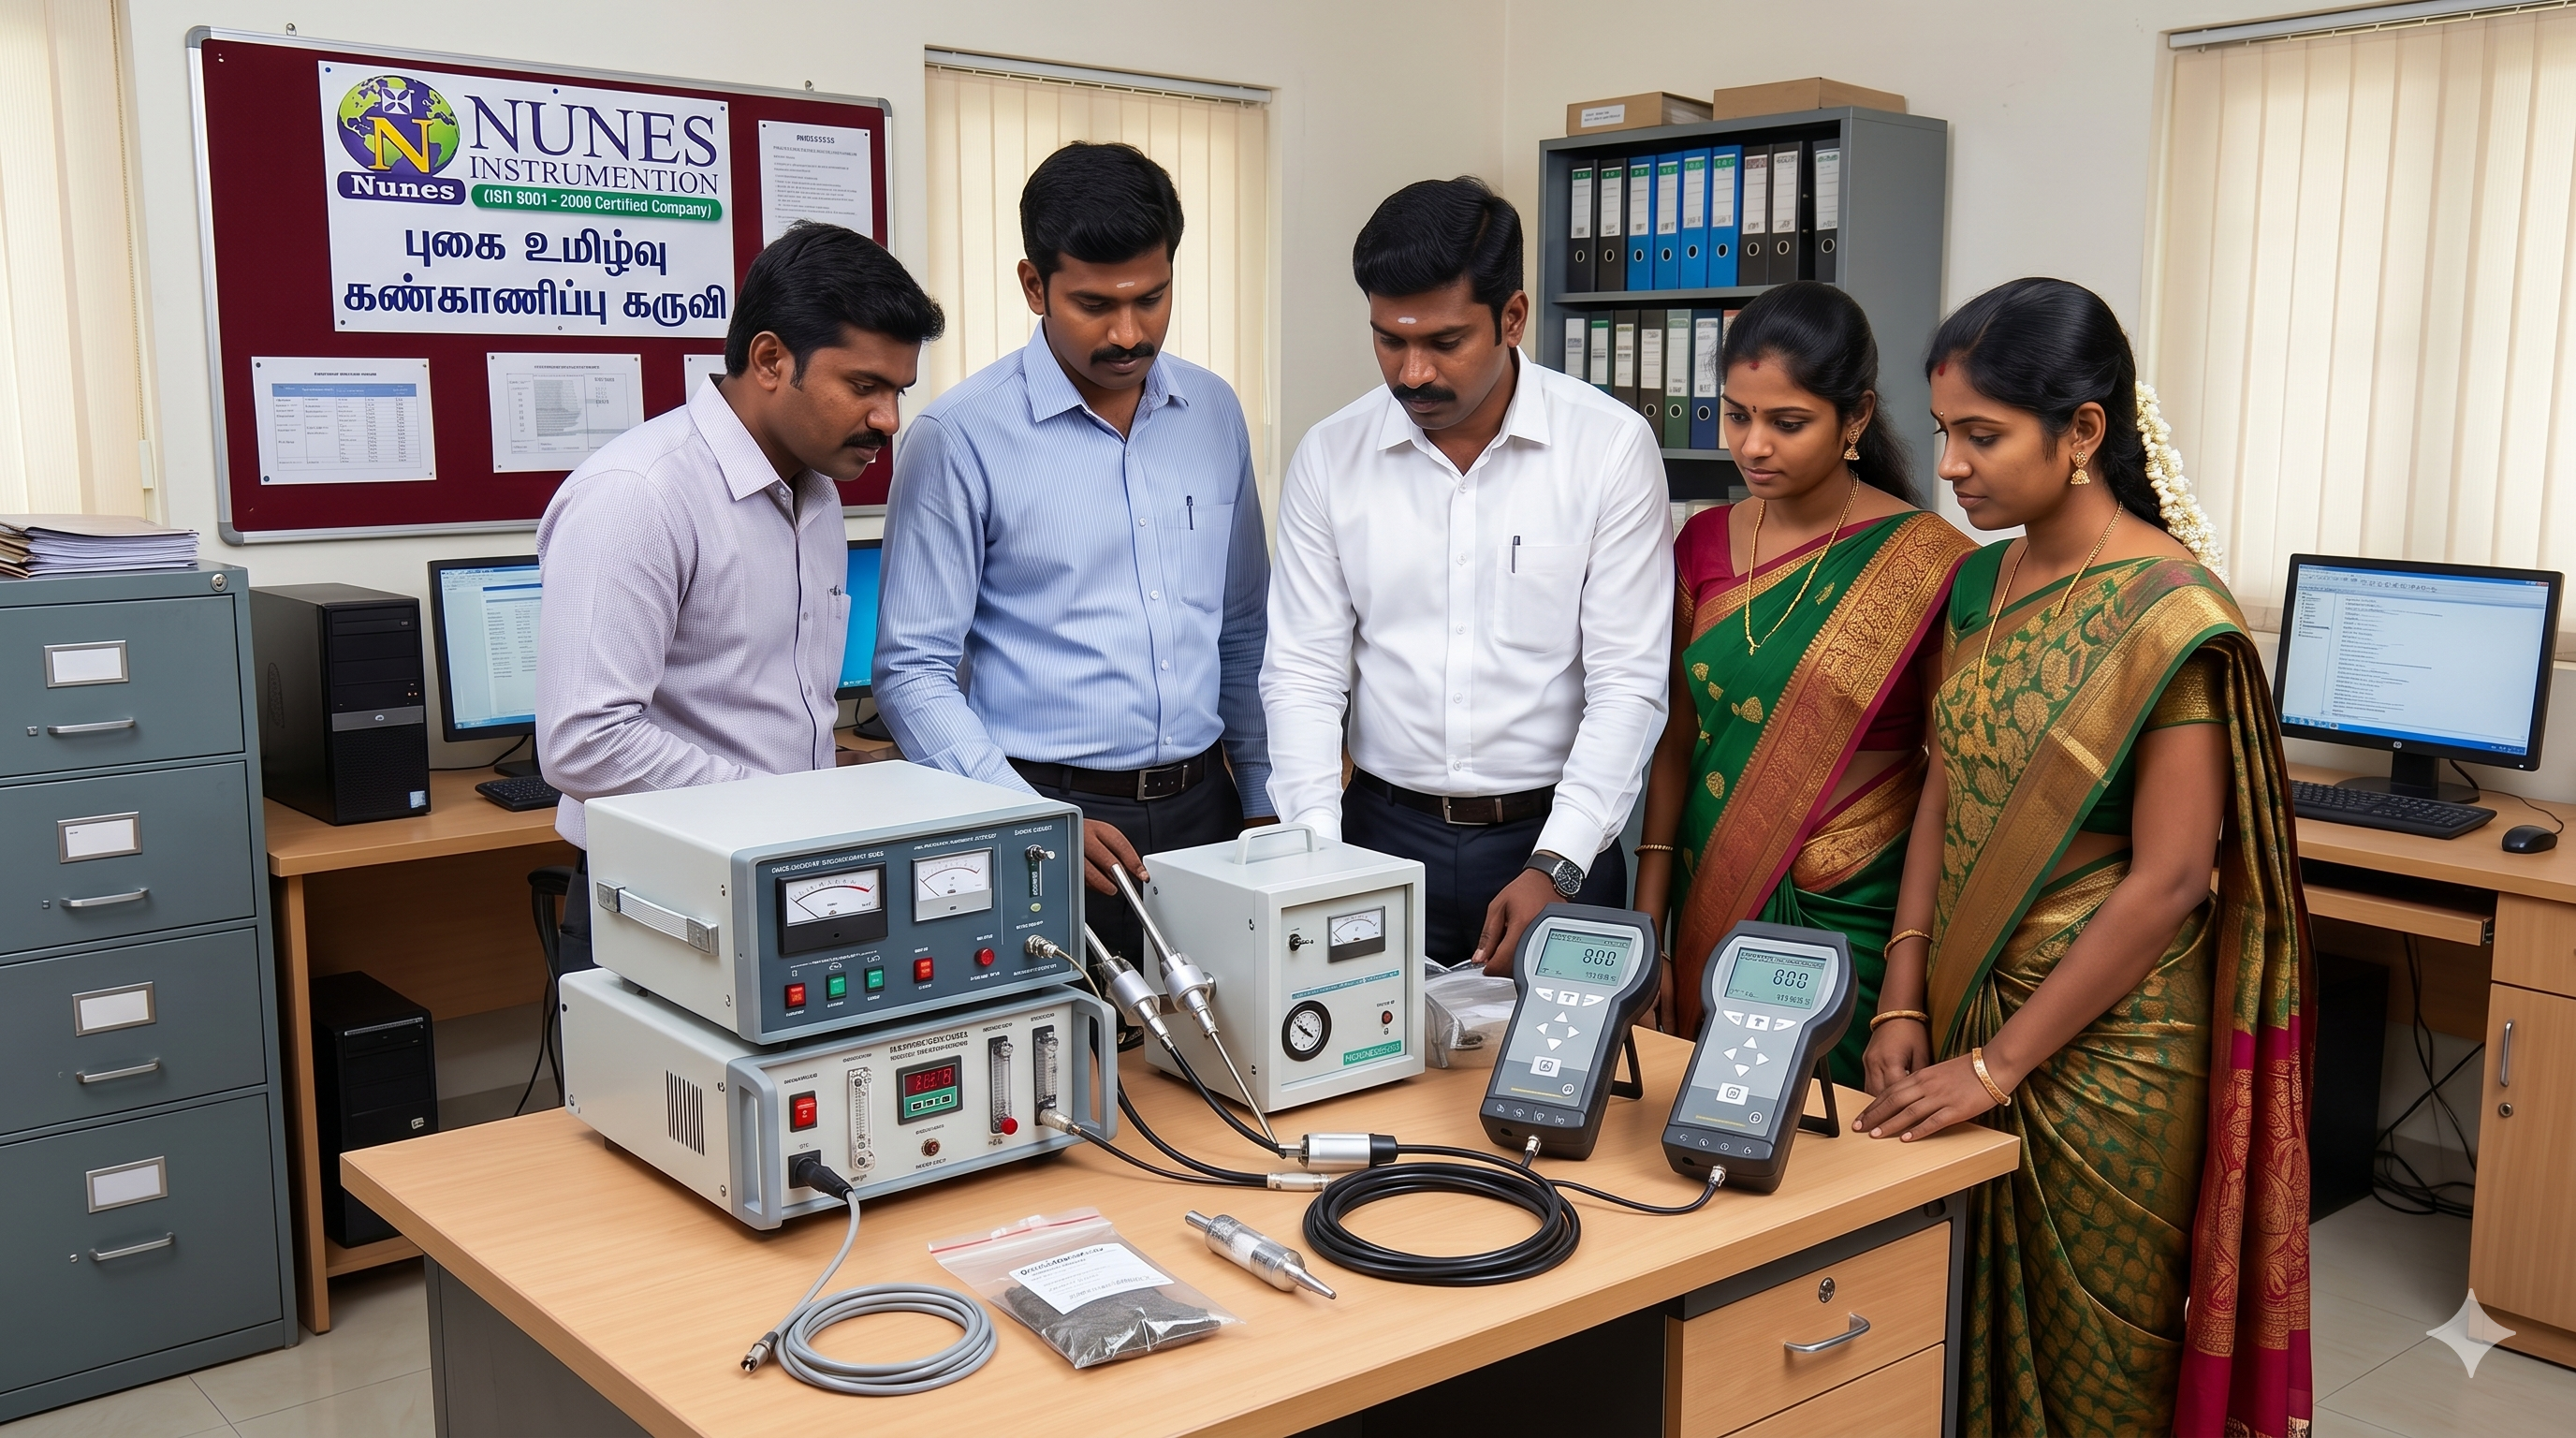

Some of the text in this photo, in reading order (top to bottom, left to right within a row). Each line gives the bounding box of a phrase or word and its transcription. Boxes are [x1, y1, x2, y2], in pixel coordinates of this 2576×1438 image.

[464, 95, 717, 168] NUNES
[351, 174, 456, 200] Nunes
[469, 155, 719, 195] INSTRUMENTION
[560, 194, 592, 210] 2000
[594, 196, 648, 213] Certified
[651, 199, 712, 219] Company)
[405, 227, 666, 276] புகை உமிழ்வு
[344, 272, 726, 327] கண்காணிப்பு கருவி
[1582, 948, 1617, 966] 800
